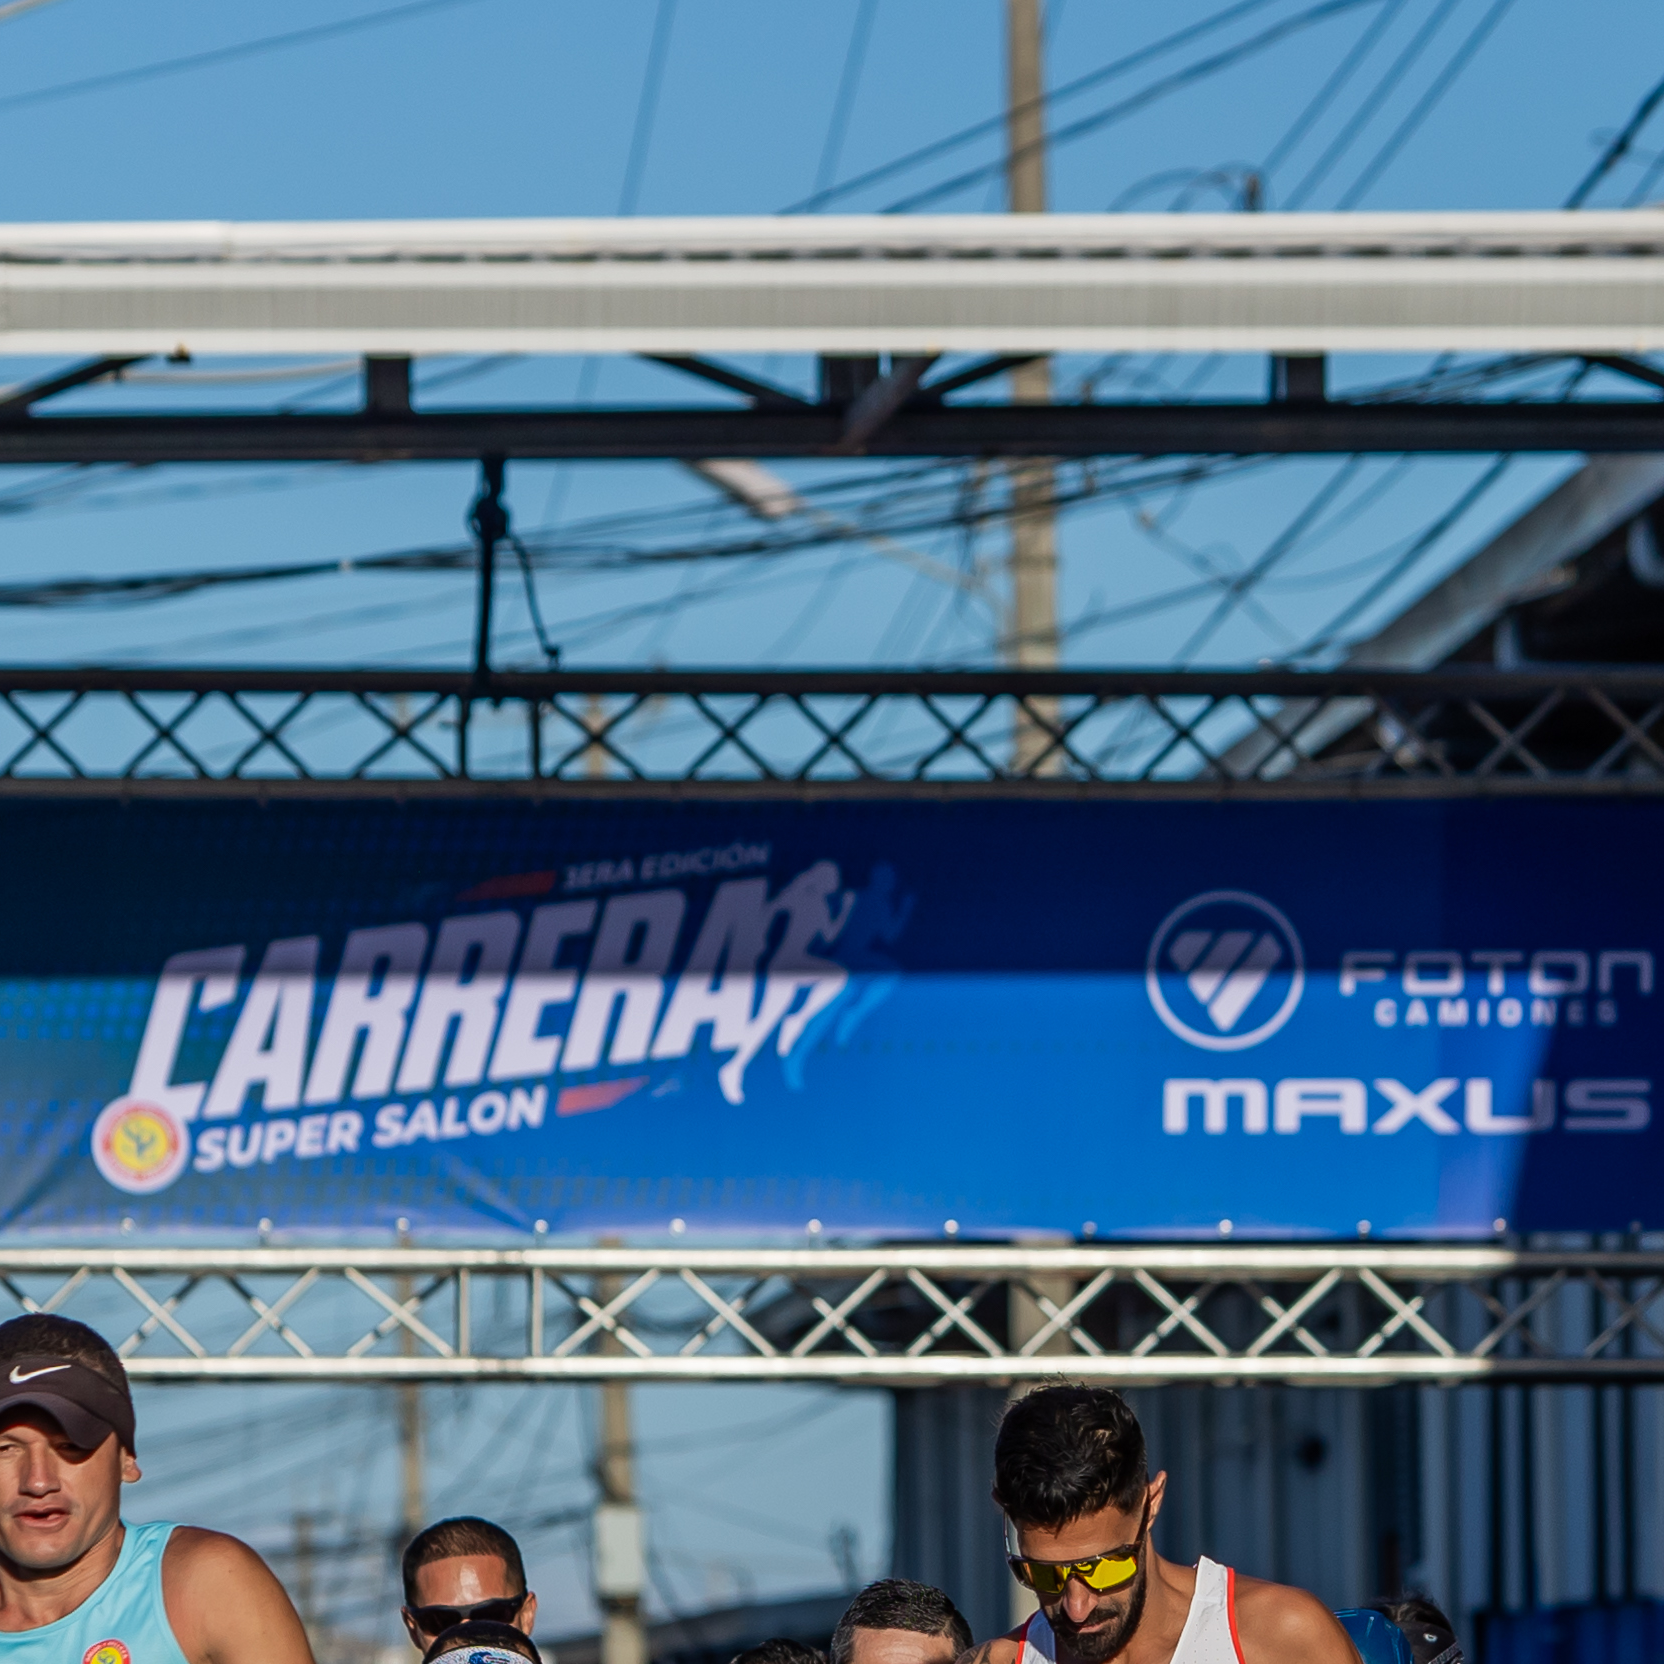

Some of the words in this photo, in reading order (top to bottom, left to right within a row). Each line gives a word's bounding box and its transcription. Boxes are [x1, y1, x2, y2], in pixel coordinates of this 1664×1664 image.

[640, 842, 771, 882] EDICIÓN
[1338, 950, 1654, 997] FOTON
[125, 878, 774, 1123] CARRERA
[1373, 998, 1618, 1028] CAMIONES
[194, 1110, 363, 1174] SUPER
[371, 1086, 549, 1150] SALON
[1162, 1076, 1652, 1136] MAXUS
